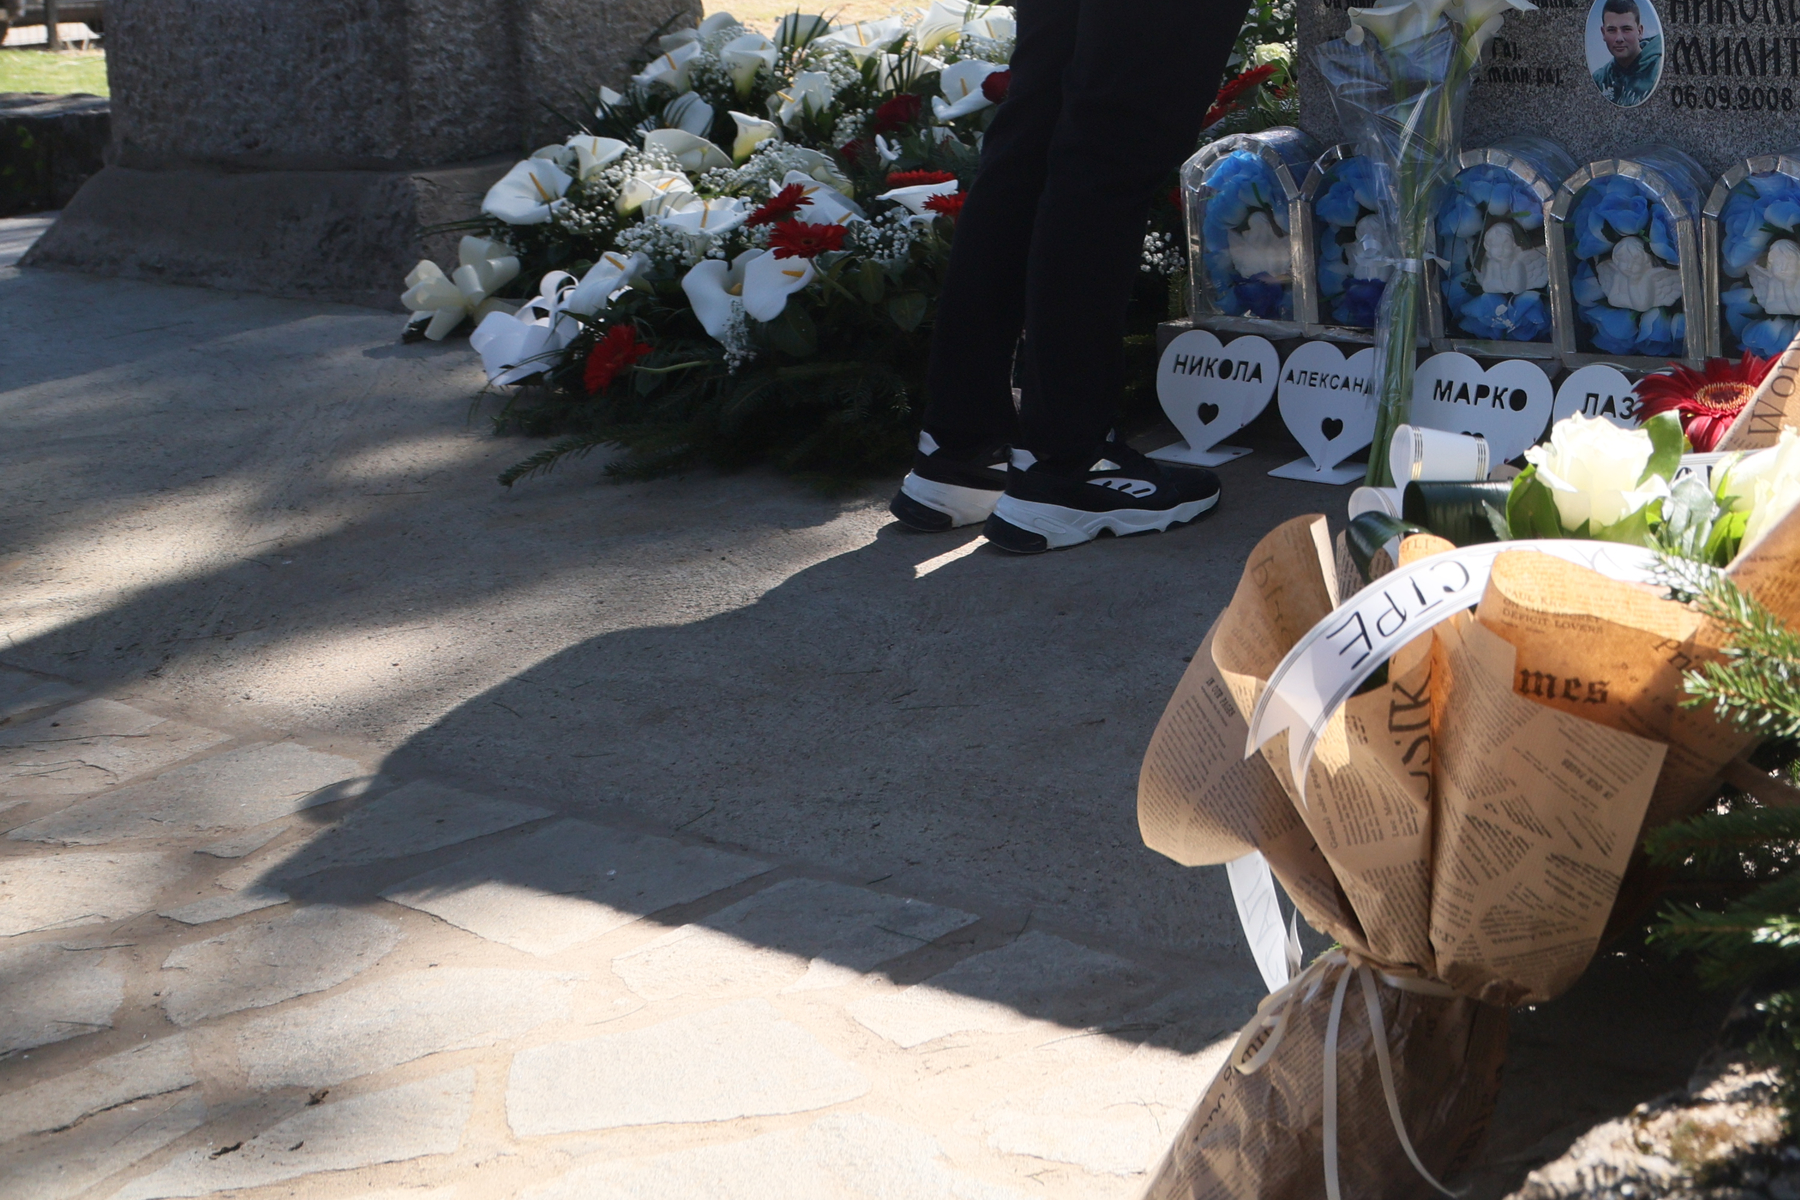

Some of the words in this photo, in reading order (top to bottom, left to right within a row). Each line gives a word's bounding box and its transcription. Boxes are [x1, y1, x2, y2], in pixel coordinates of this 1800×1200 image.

[1672, 86, 1794, 113] 06.09.2008
[1172, 353, 1264, 385] НИКОЛА
[1433, 378, 1528, 412] МАРКО
[1518, 668, 1610, 704] mes
